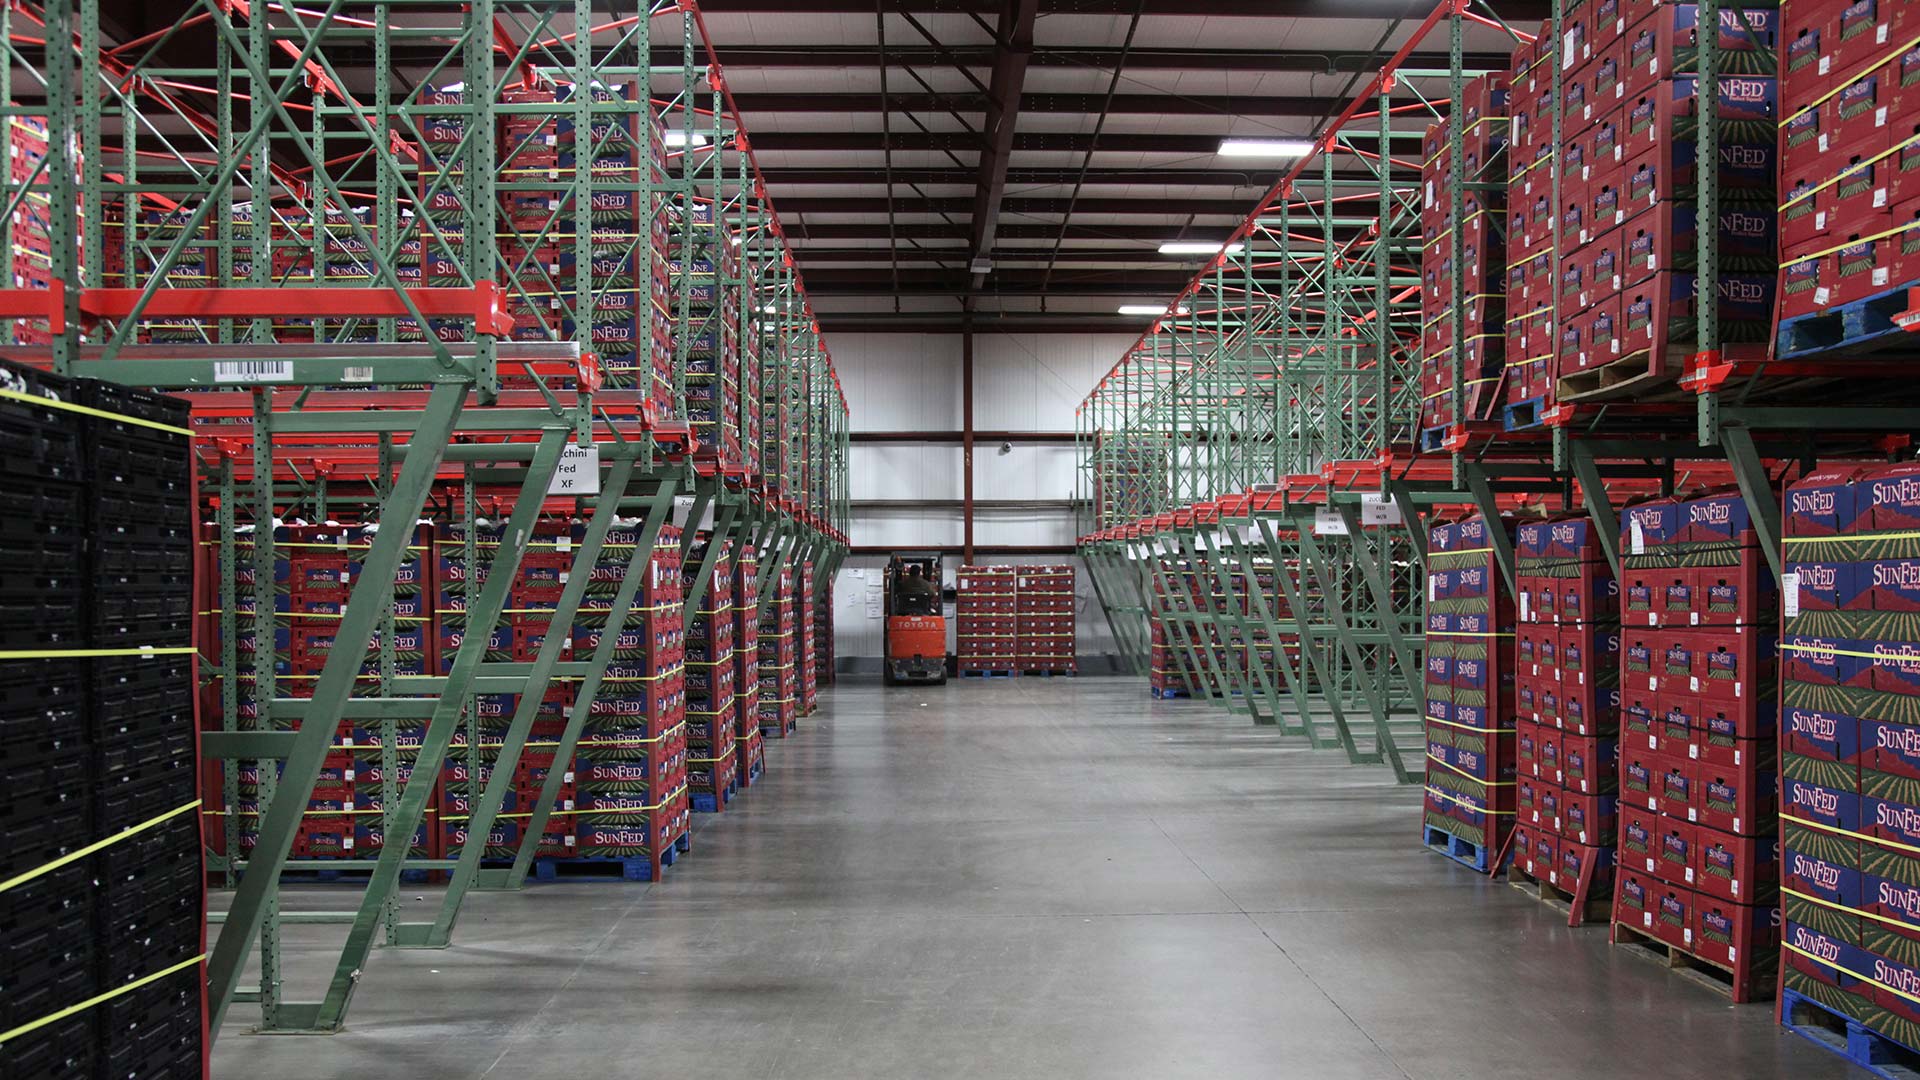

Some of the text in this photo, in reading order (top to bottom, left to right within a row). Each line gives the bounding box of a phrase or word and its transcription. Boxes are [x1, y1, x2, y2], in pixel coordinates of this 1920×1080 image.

[561, 449, 587, 458] chini
[558, 464, 576, 473] Fed
[561, 479, 574, 489] XF
[1793, 490, 1834, 513] SUNFED
[1630, 508, 1662, 526] SUNFED
[1690, 502, 1729, 523] SUNFED
[1432, 528, 1449, 543] SUNFED
[1461, 522, 1482, 538] SUNFED
[1520, 528, 1538, 542] SUNFED
[1552, 525, 1575, 541] SUNFED
[1460, 569, 1481, 585] SUNFED
[1794, 565, 1835, 586] SUNFED
[897, 621, 937, 629] TOYOTA
[1431, 615, 1447, 629] SUNFED
[1460, 616, 1480, 631] SUNFED
[1793, 638, 1836, 659] SUNFED
[1429, 658, 1445, 672] SUNFED
[1458, 661, 1478, 677] SUNFED
[592, 701, 640, 713] SUNFED
[1429, 702, 1446, 717] SUNFED
[1458, 706, 1477, 723] SUNFED
[1792, 711, 1835, 736] SUNFED
[592, 734, 640, 747] SUNFED
[1877, 725, 1920, 751] SUNFE
[1458, 751, 1477, 768] SUNFED
[593, 765, 641, 778] SUNFED
[594, 799, 643, 810] SUNFED
[1793, 783, 1837, 811] SUNFED
[1877, 802, 1920, 831] SUNFE
[595, 831, 644, 844] SUNFED
[1794, 854, 1838, 884] SUNFED
[1795, 927, 1838, 962] SUNFED
[1874, 959, 1920, 997] SUNFE
